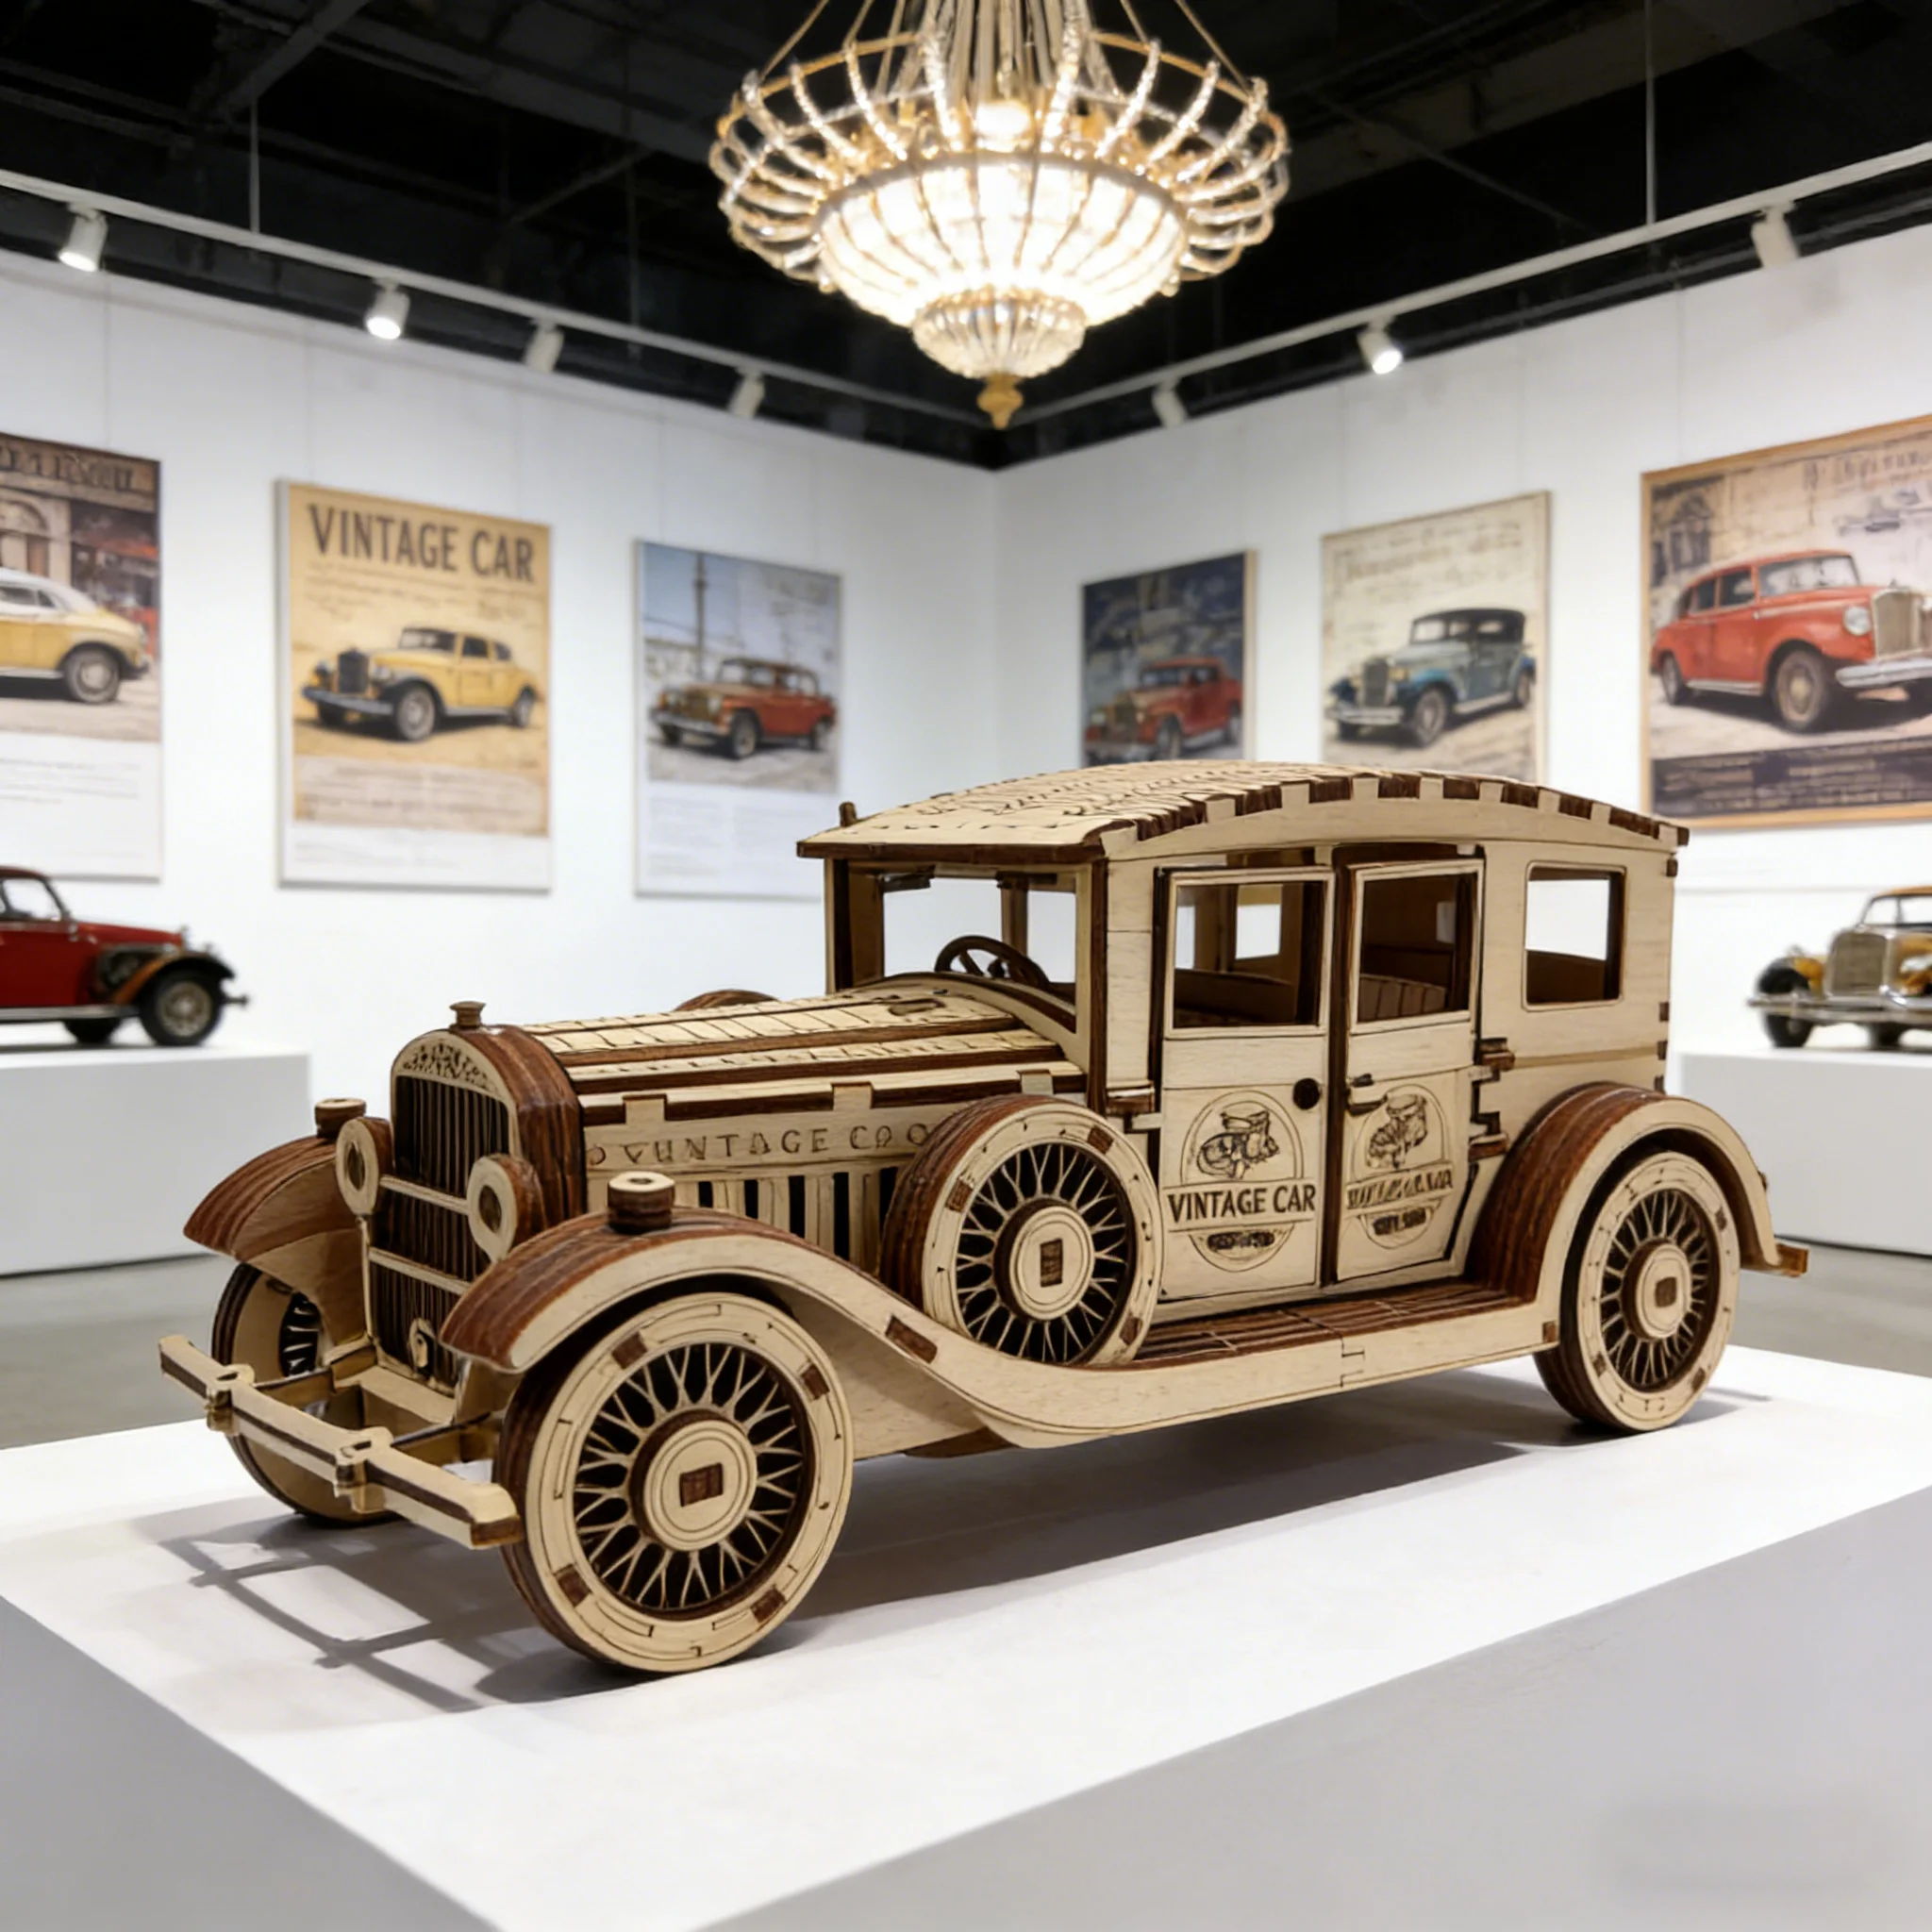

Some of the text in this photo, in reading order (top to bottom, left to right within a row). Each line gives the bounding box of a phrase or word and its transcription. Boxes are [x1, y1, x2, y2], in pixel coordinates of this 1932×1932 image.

[307, 503, 535, 584] VINTAGE CAR
[1167, 1187, 1268, 1224] VINTAGE
[1273, 1184, 1316, 1214] CAR
